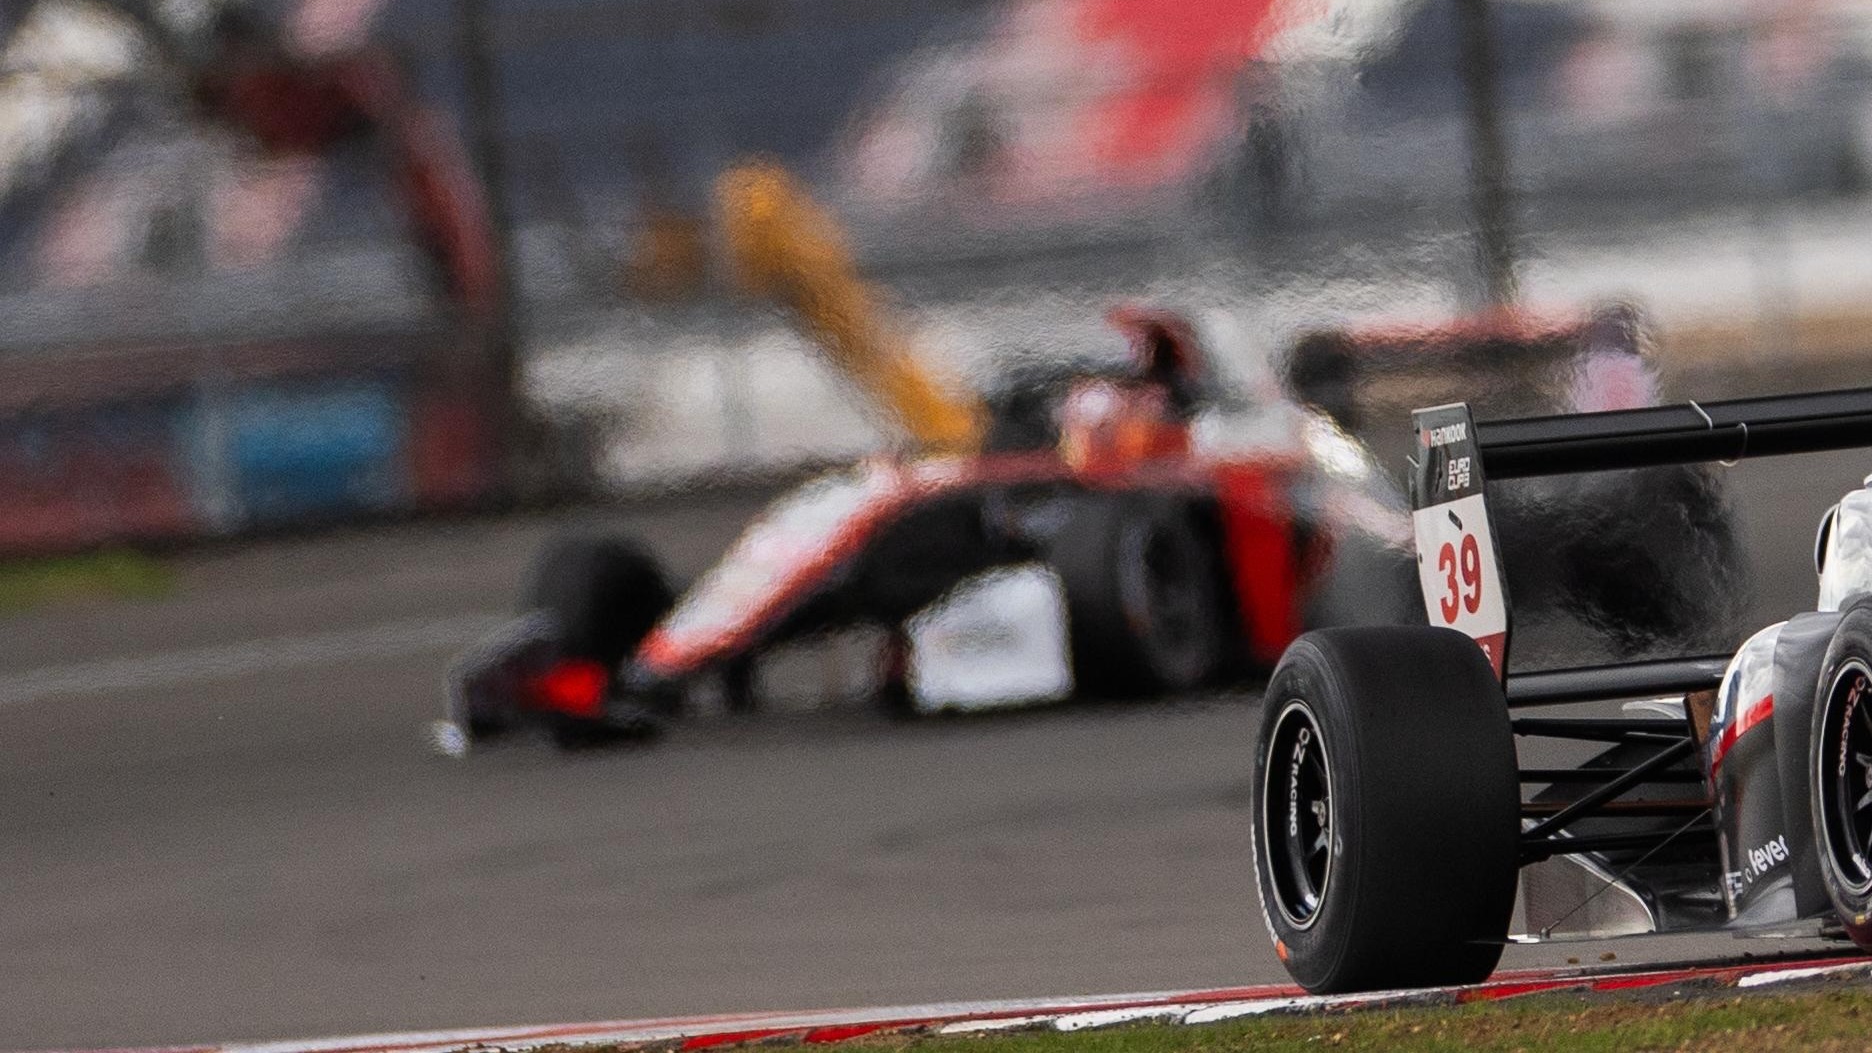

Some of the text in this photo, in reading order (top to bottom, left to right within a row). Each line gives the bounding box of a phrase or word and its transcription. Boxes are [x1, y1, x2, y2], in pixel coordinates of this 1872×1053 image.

[1439, 533, 1482, 624] 39
[1290, 728, 1310, 837] OZ RACING
